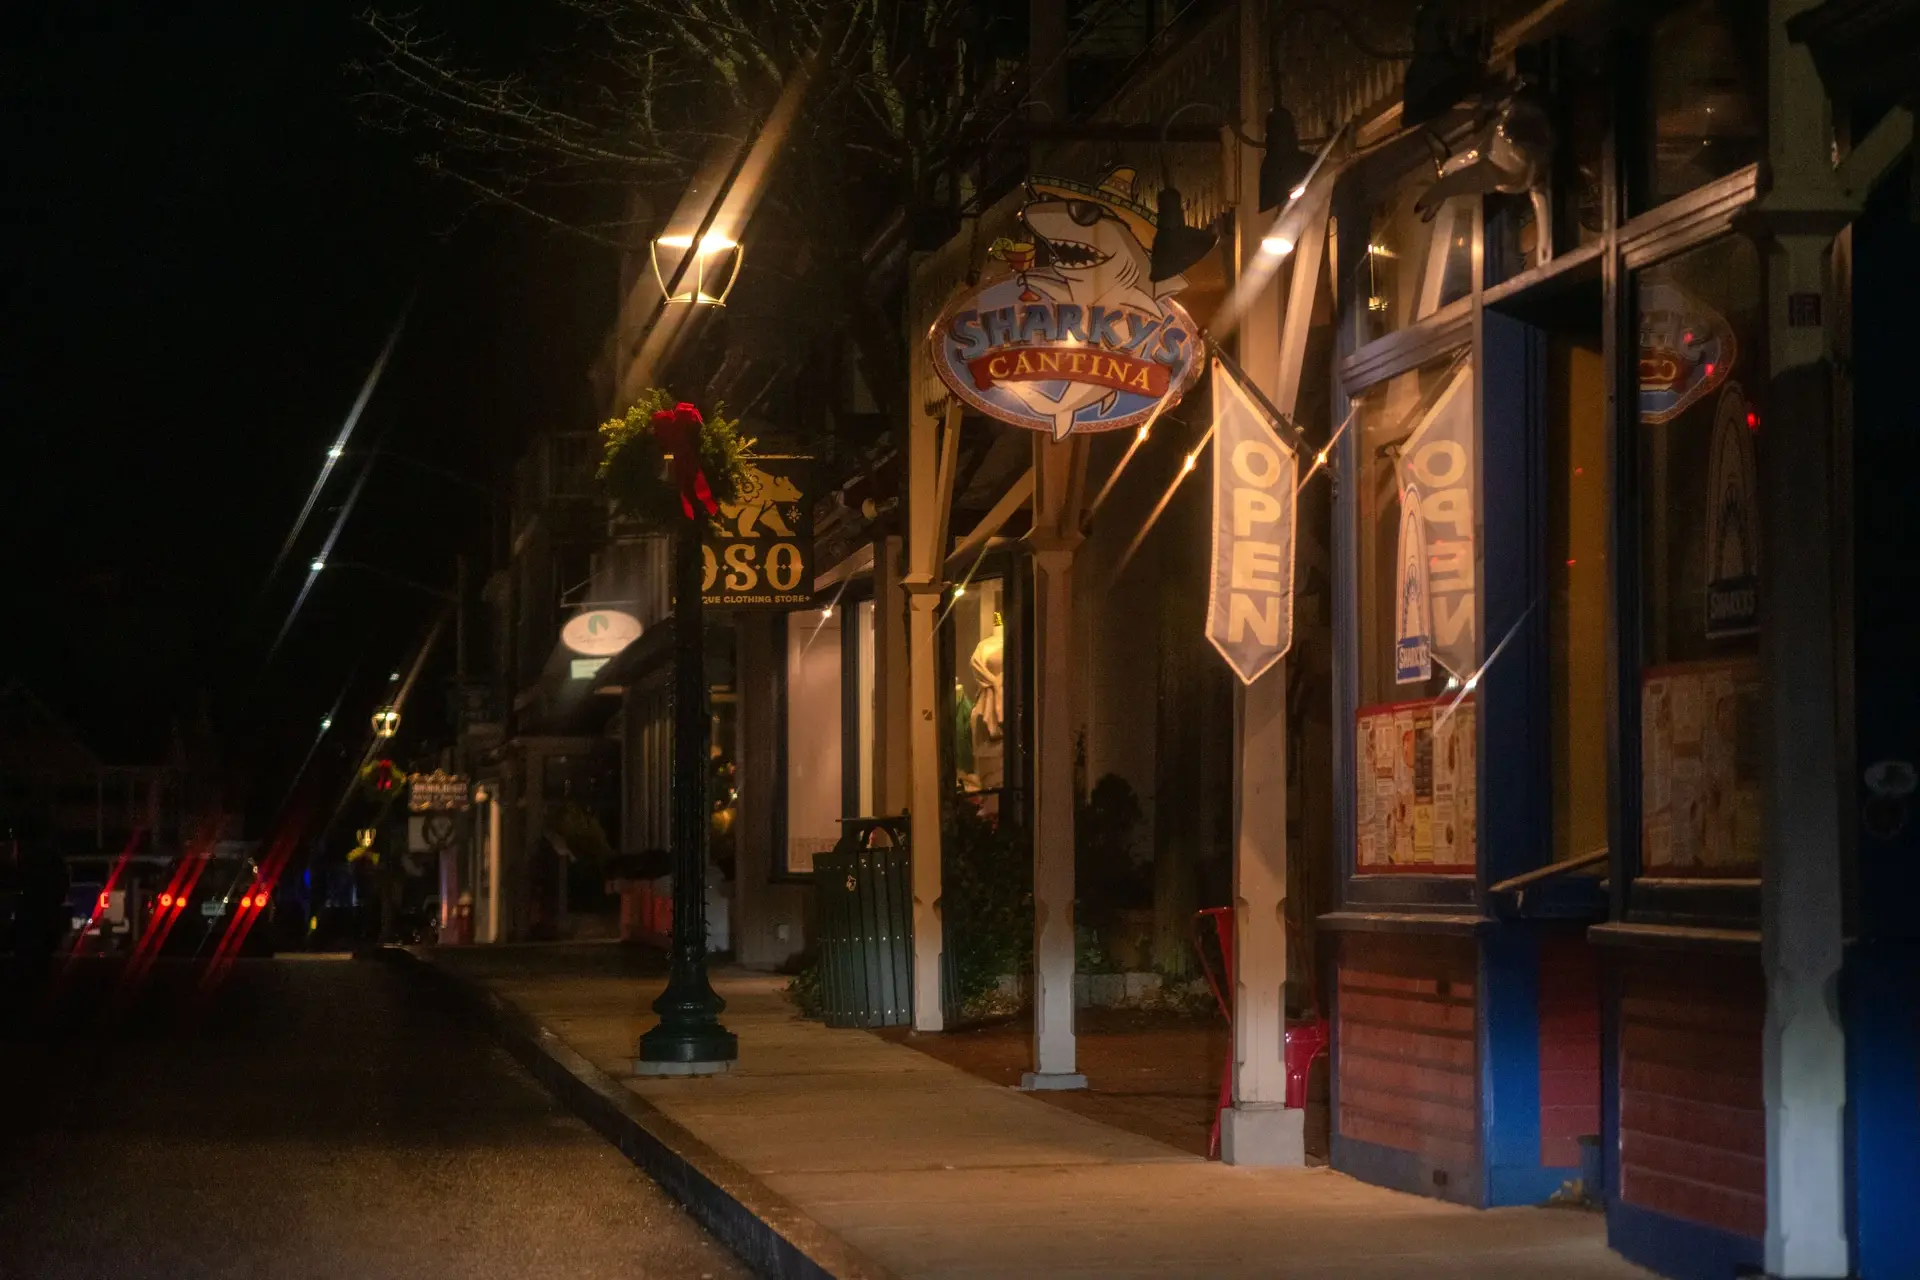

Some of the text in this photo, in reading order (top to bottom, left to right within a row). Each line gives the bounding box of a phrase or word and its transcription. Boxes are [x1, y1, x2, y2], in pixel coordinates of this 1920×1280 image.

[951, 304, 1187, 363] SHARKY'S
[988, 350, 1150, 390] CANTINA
[1230, 441, 1280, 646] OPEN
[724, 596, 771, 604] CLOTHING
[774, 595, 804, 603] STORE
